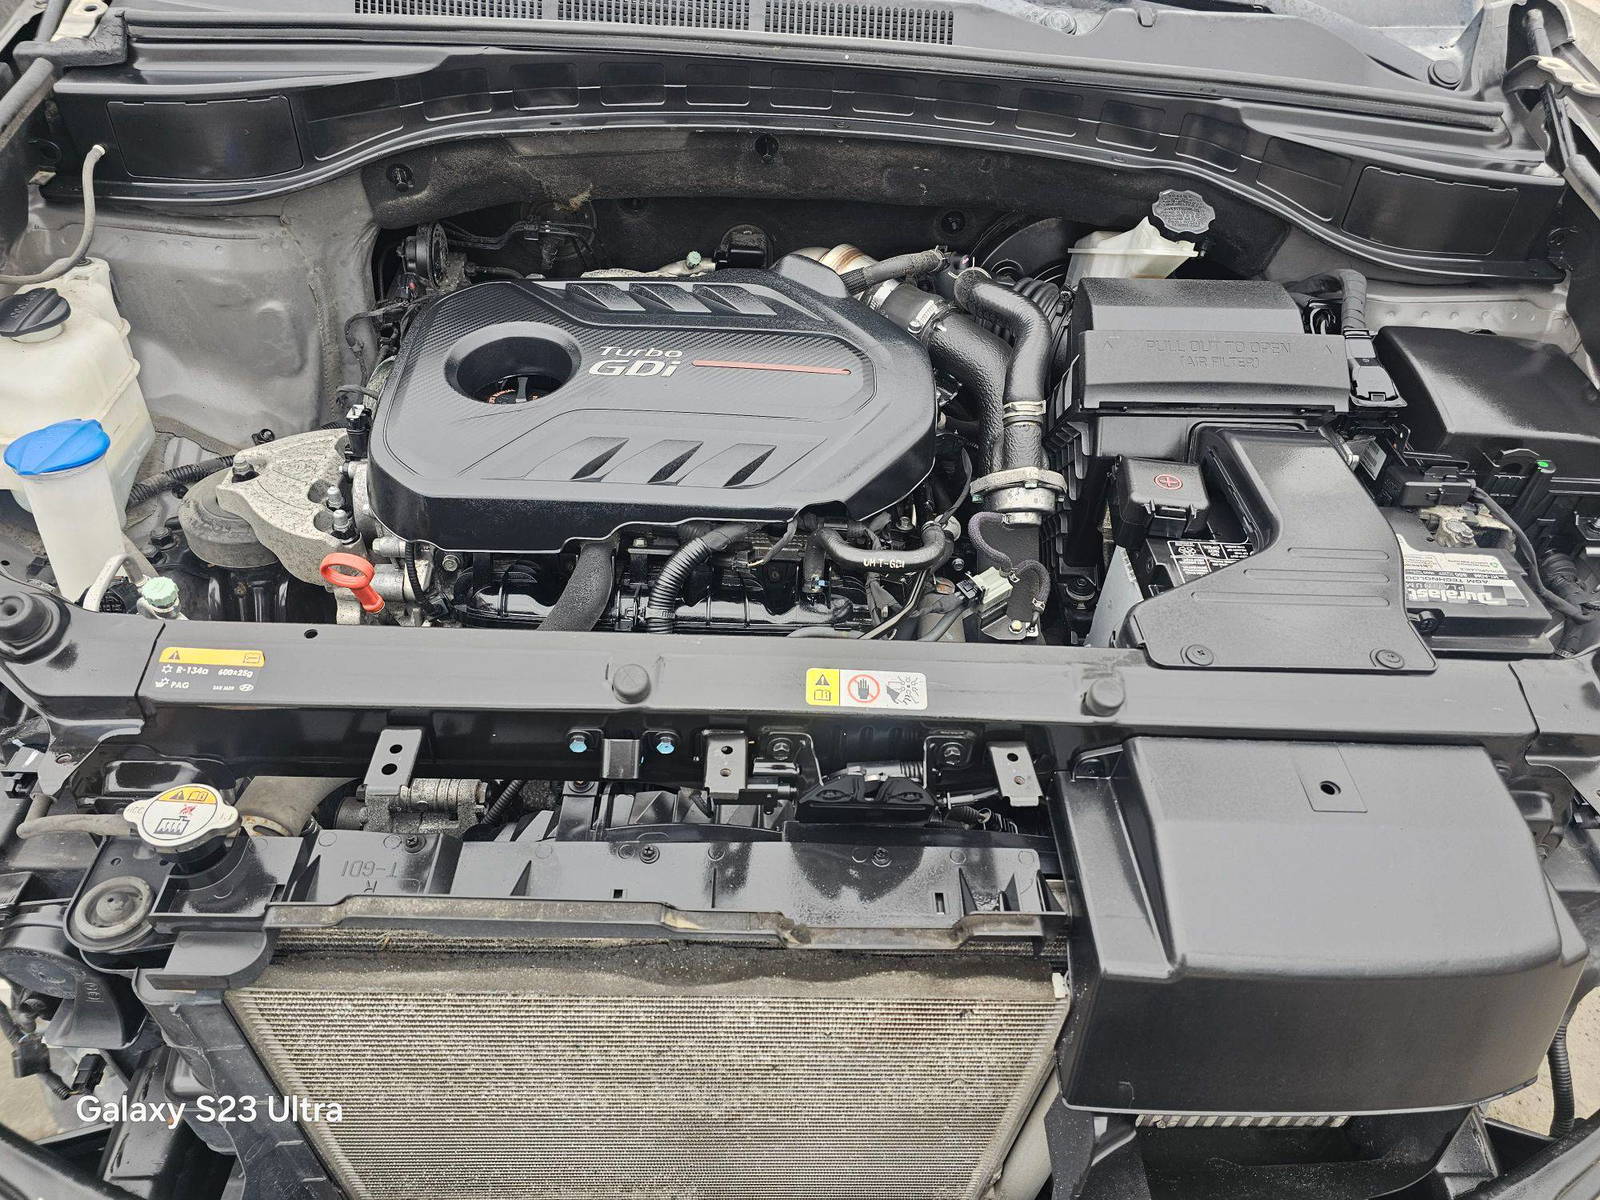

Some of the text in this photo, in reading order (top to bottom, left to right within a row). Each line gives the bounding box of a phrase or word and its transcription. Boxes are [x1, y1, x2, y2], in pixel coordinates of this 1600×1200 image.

[600, 346, 683, 358] Turbo
[1146, 340, 1291, 354] PULL OUT TO OPEN
[588, 359, 681, 377] GDi
[1405, 575, 1463, 583] TECHNOLOG
[1406, 588, 1507, 606] Duralast
[176, 666, 209, 676] R-134a
[170, 681, 190, 690] PAG
